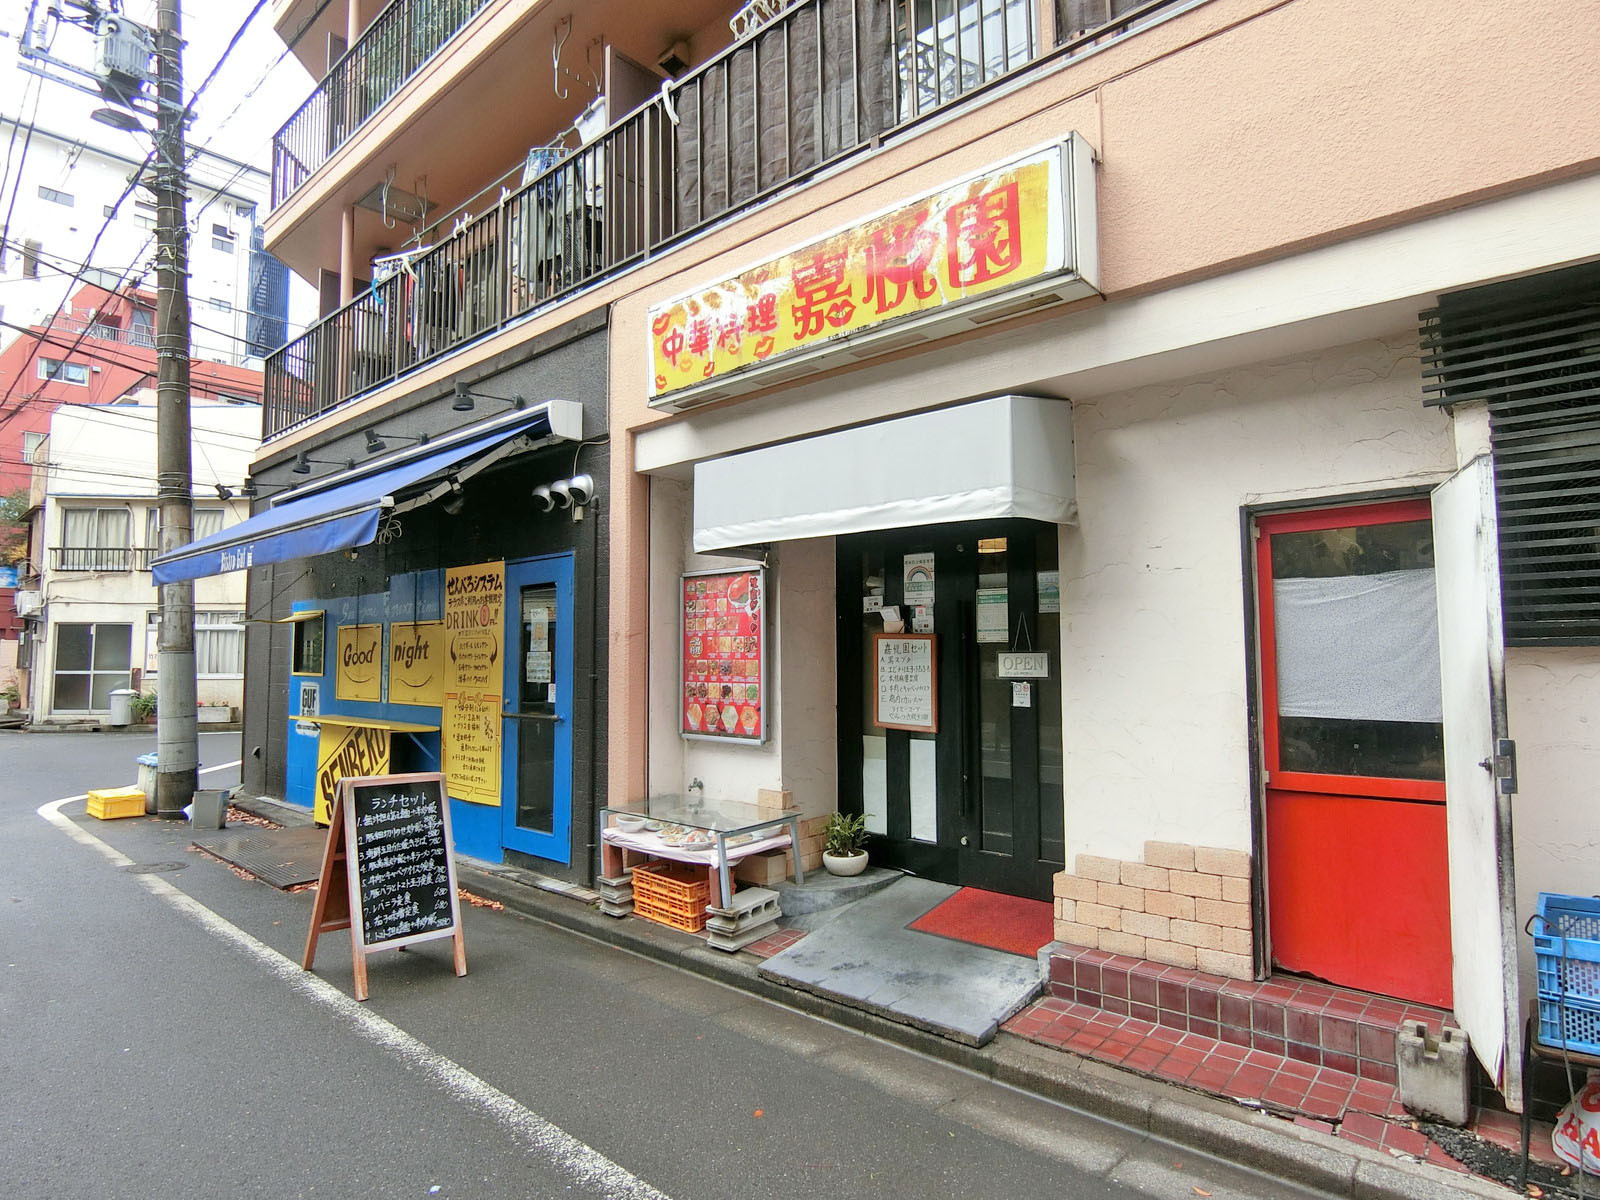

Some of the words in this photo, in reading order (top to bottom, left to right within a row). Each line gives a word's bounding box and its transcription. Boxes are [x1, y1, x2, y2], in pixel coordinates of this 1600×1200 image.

[662, 292, 777, 366] 中華料理
[447, 574, 503, 596] せんべろシステム
[446, 610, 479, 630] DRINK
[344, 641, 377, 668] Good
[394, 634, 430, 669] night
[1003, 656, 1044, 671] OPEN
[302, 688, 317, 708] GUF
[372, 792, 427, 810] ランチセット
